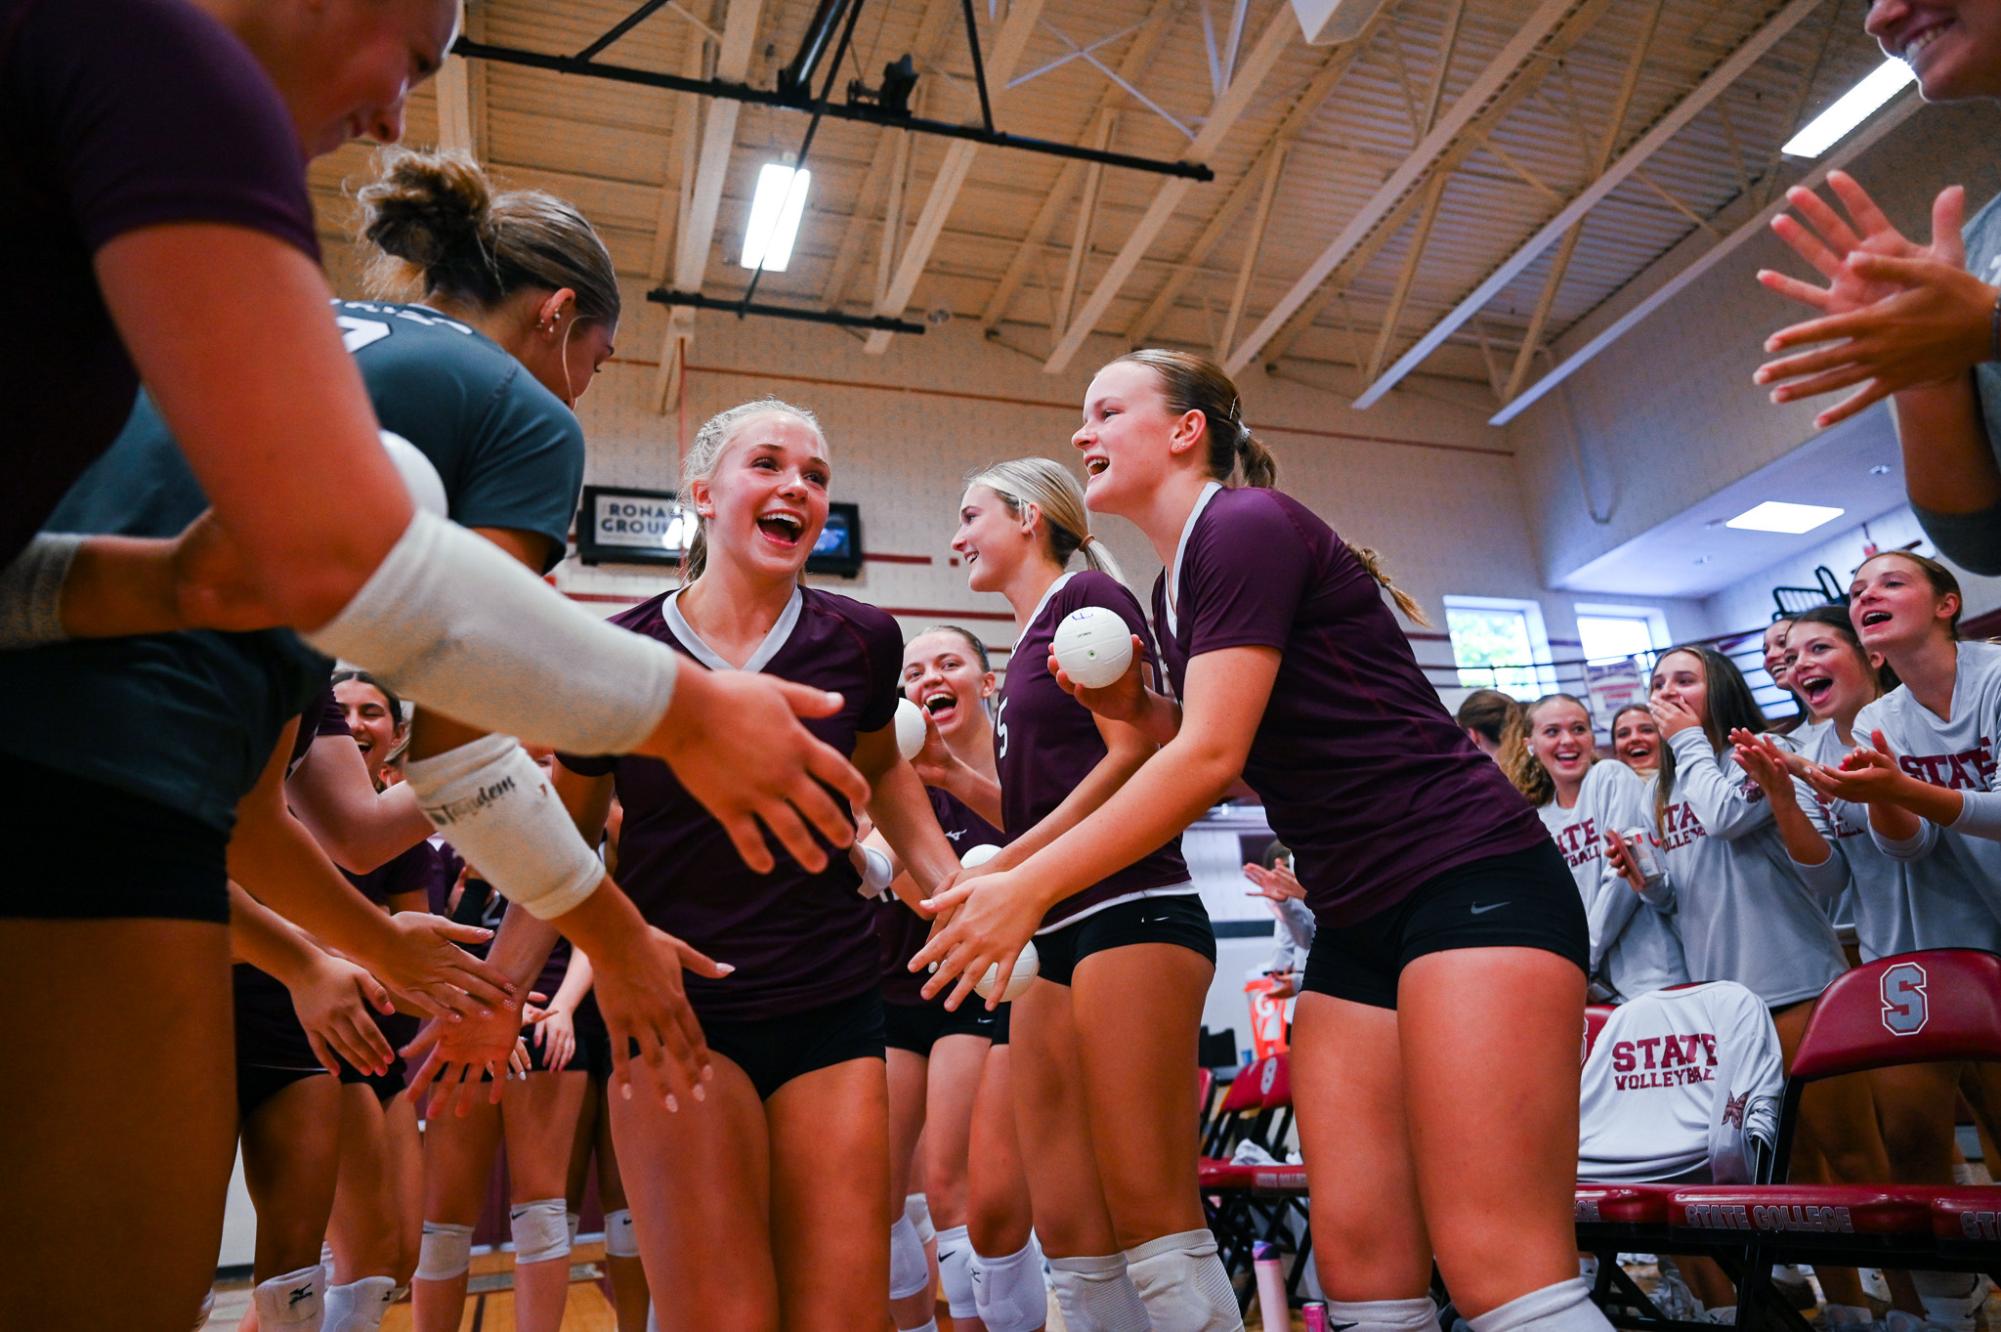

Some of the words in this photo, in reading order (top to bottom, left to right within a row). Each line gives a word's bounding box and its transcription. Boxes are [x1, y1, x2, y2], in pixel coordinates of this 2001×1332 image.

[997, 696, 1008, 759] 5
[1880, 961, 1929, 1036] S
[1612, 1033, 1718, 1073] STATE
[1614, 1067, 1716, 1091] VOLLEYBAL
[1684, 1204, 1752, 1230] STATE
[1753, 1204, 1856, 1233] COLLEGE
[1959, 1210, 2001, 1240] ST
